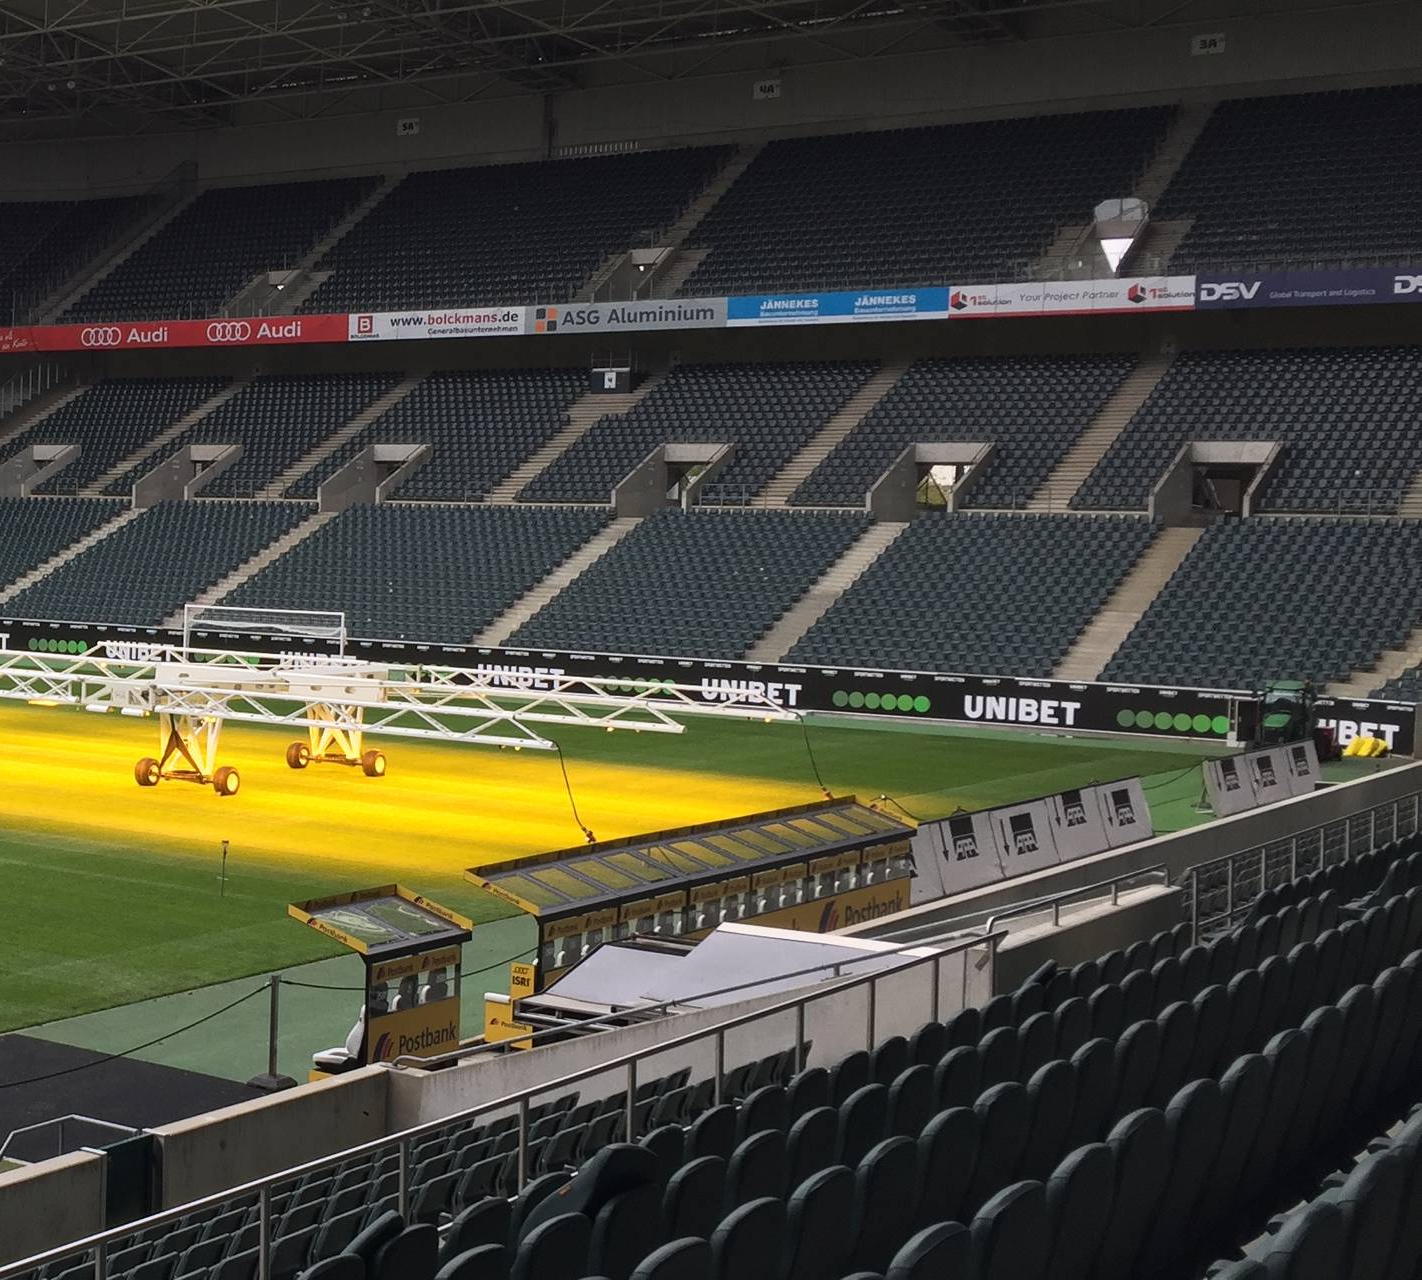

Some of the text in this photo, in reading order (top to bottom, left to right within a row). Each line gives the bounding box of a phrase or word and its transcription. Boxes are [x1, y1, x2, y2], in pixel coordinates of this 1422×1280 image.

[1019, 290, 1120, 303] Your Project Partner
[1200, 281, 1262, 301] DSV
[1329, 289, 1342, 297] and
[390, 310, 519, 328] www.bolckmans.de
[561, 305, 715, 326] ASG Aluminium
[127, 327, 168, 343] Audi
[257, 321, 302, 339] Audi
[702, 677, 802, 707] UNIBET
[964, 694, 1081, 726] UNIBET
[845, 889, 903, 927] Postbank
[512, 975, 530, 987] ISRI
[399, 1021, 457, 1054] Postbank
